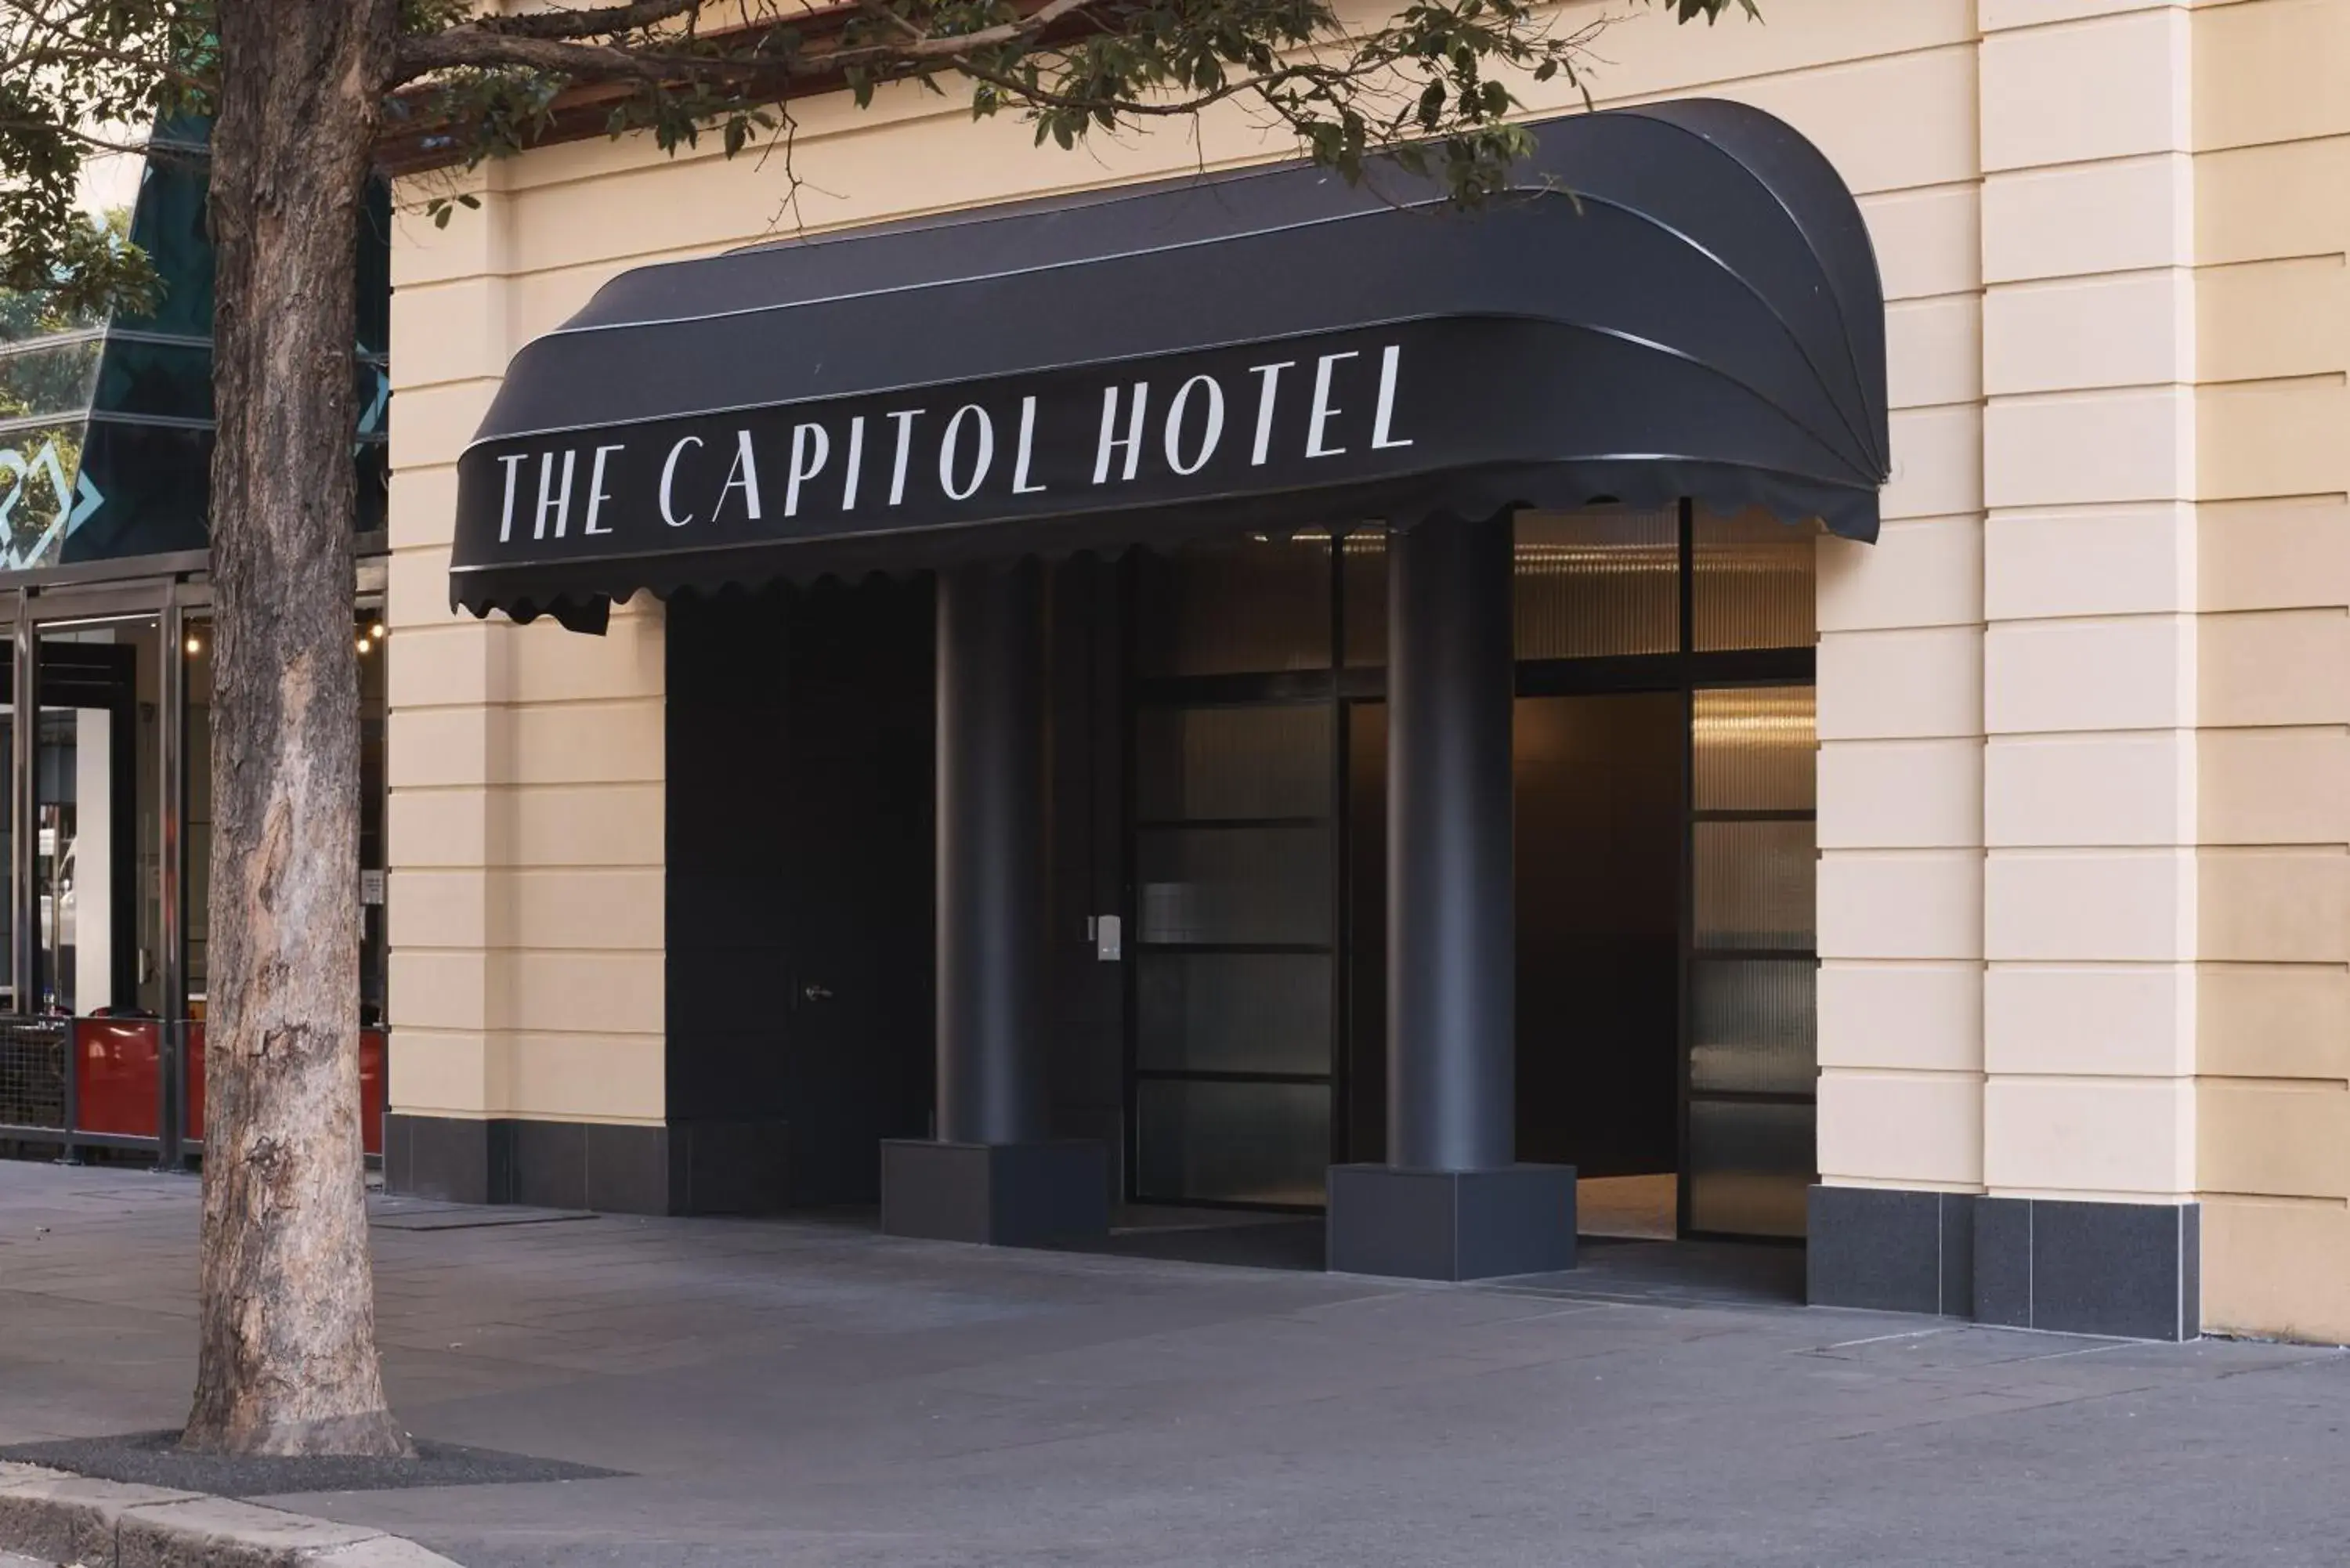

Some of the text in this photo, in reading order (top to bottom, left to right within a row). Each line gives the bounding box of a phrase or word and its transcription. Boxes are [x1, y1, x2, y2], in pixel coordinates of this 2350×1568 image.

[497, 345, 1414, 543] THE CAPITOL HOTEL
